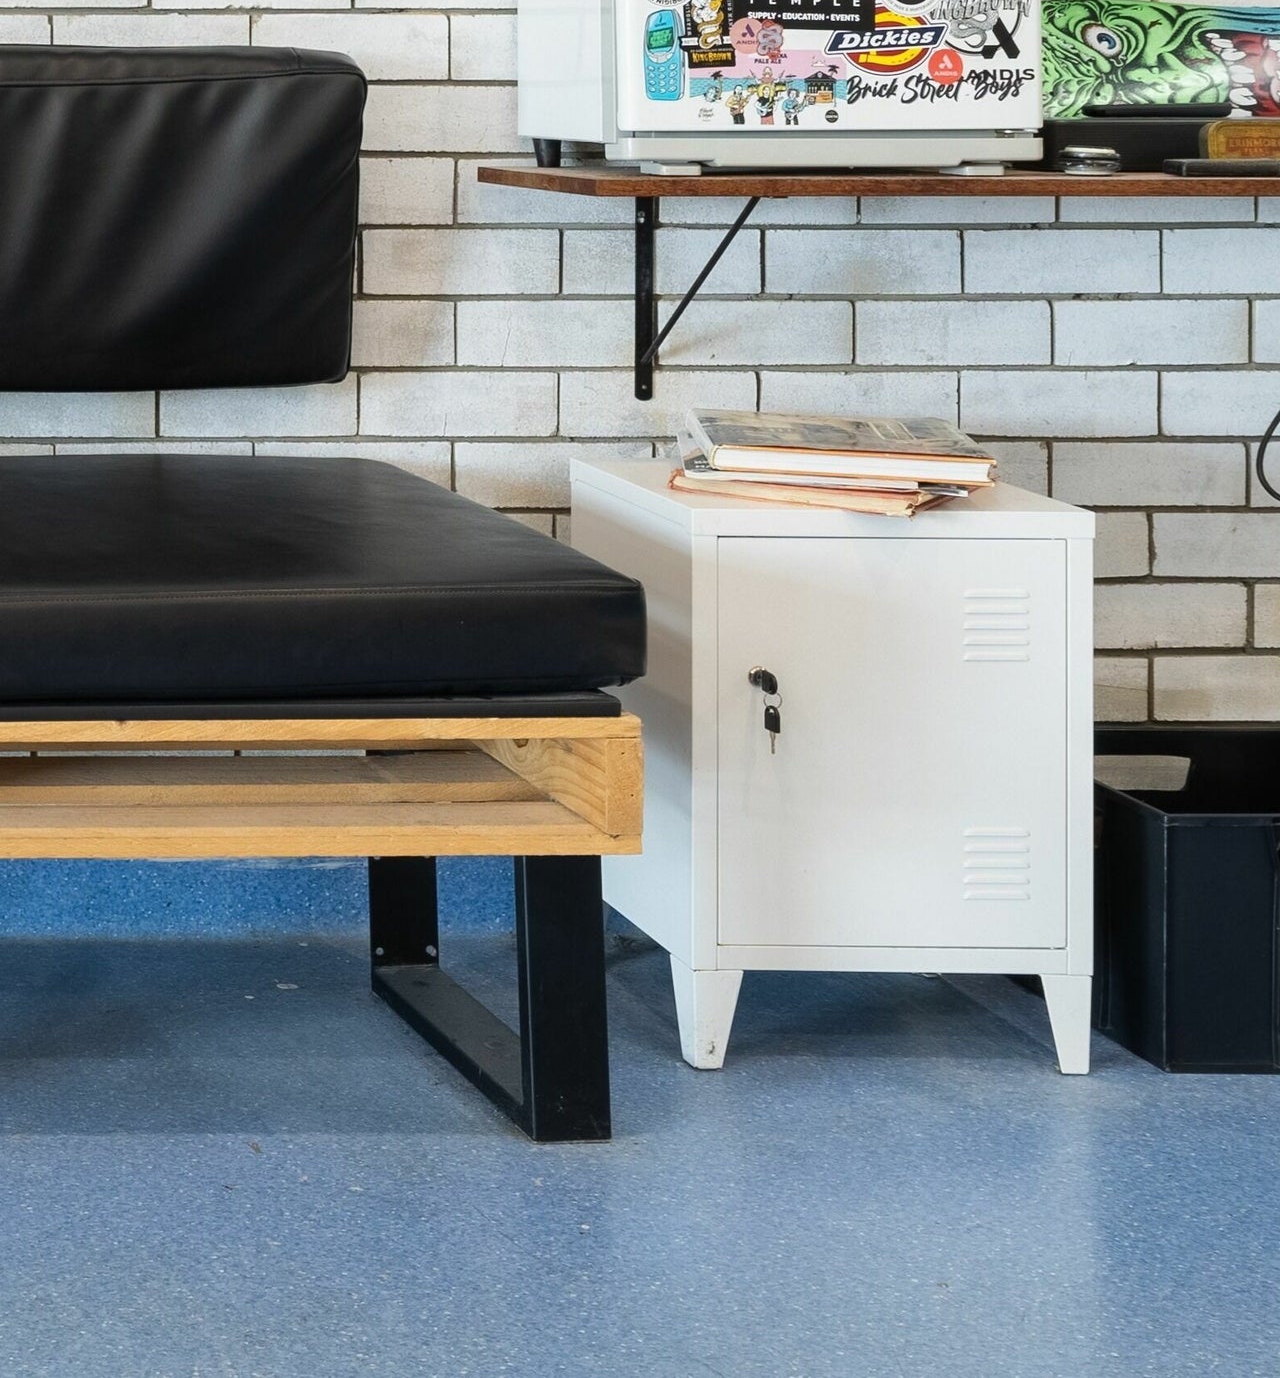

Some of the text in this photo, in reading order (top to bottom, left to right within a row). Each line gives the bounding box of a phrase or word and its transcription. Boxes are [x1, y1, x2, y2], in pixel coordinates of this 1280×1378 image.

[747, 11, 861, 23] SUPPLY EDUCATION EVENTS
[837, 30, 936, 50] Dickies
[967, 68, 1036, 82] ANDIS
[846, 74, 899, 105] Brick
[900, 73, 963, 104] Street
